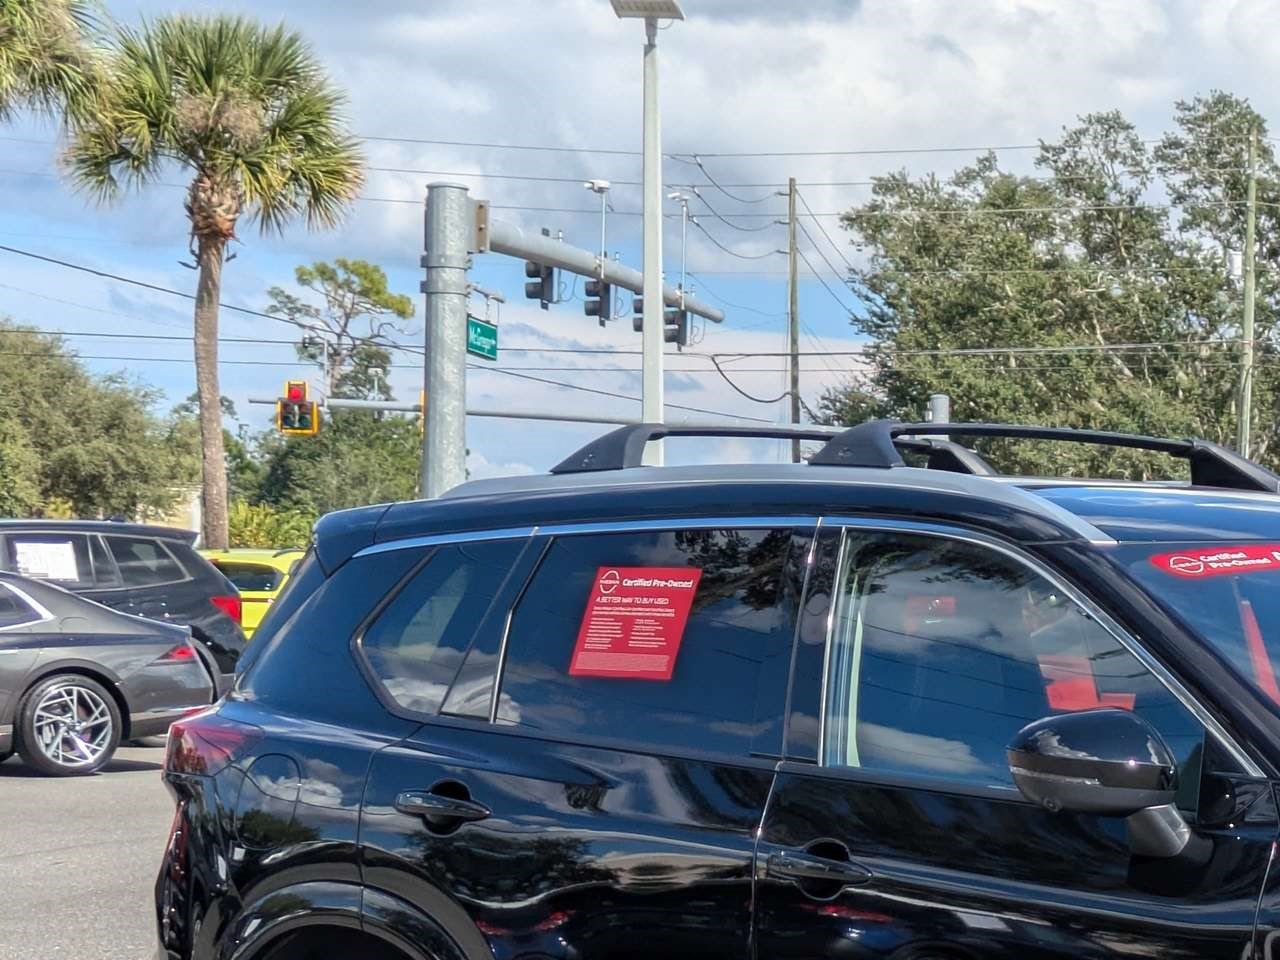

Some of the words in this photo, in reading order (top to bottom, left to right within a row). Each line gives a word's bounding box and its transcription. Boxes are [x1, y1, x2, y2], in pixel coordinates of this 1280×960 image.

[1200, 552, 1248, 563] Certified
[1209, 558, 1273, 569] Pre-Owned
[622, 578, 652, 587] Certified
[652, 579, 693, 588] Pre-Owned
